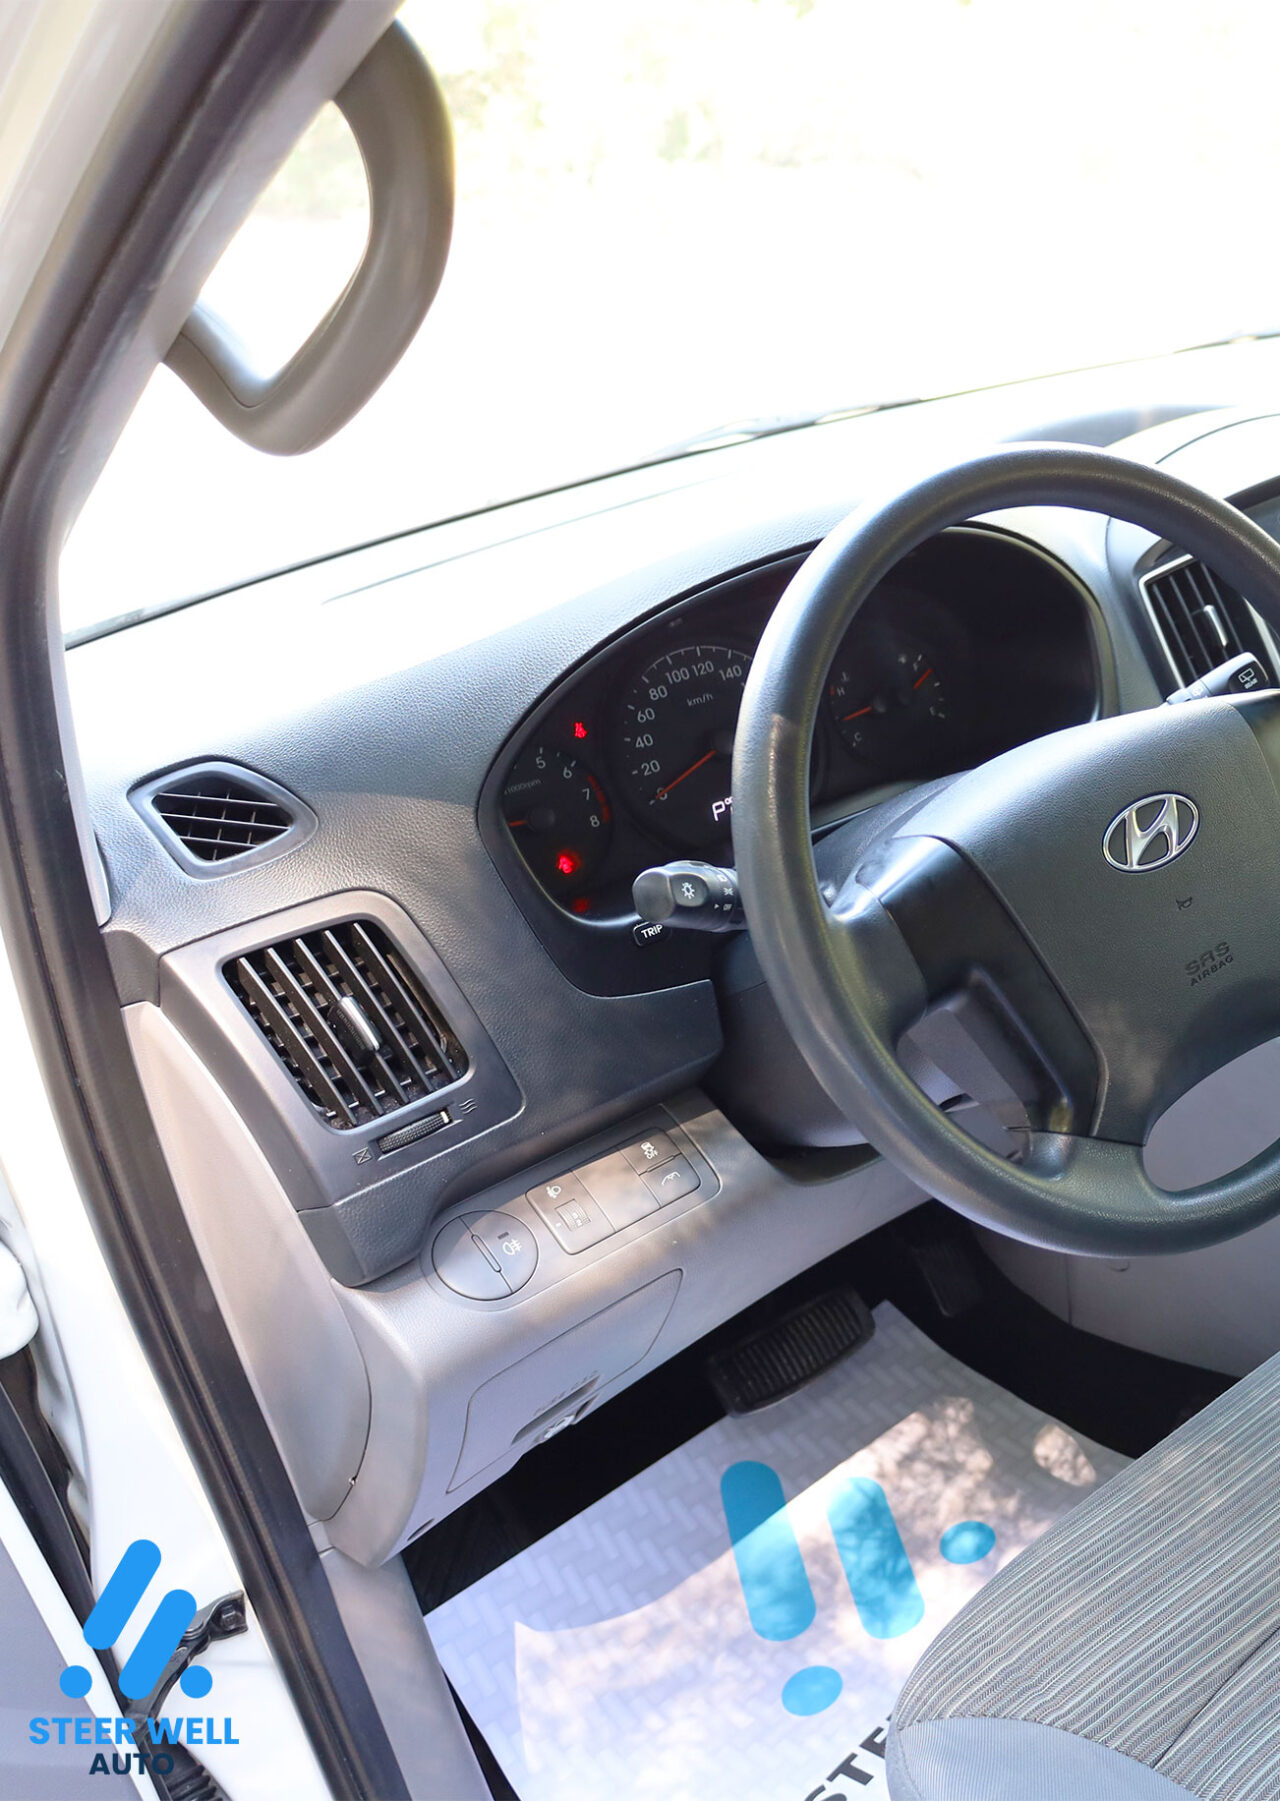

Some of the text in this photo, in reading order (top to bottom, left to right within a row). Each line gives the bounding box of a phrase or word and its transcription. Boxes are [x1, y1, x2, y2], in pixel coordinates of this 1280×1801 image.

[665, 667, 690, 684] 100
[692, 660, 715, 677] 120
[718, 664, 743, 681] 140
[649, 685, 669, 701] 80
[687, 692, 714, 707] km/h
[637, 707, 656, 723] 60
[635, 733, 654, 749] 40
[535, 756, 547, 769] 5
[641, 759, 661, 776] 20
[563, 766, 573, 779] 6
[582, 787, 591, 801] 7
[589, 815, 601, 828] 8
[641, 924, 663, 939] TRIP
[1189, 954, 1235, 987] AIRBAG
